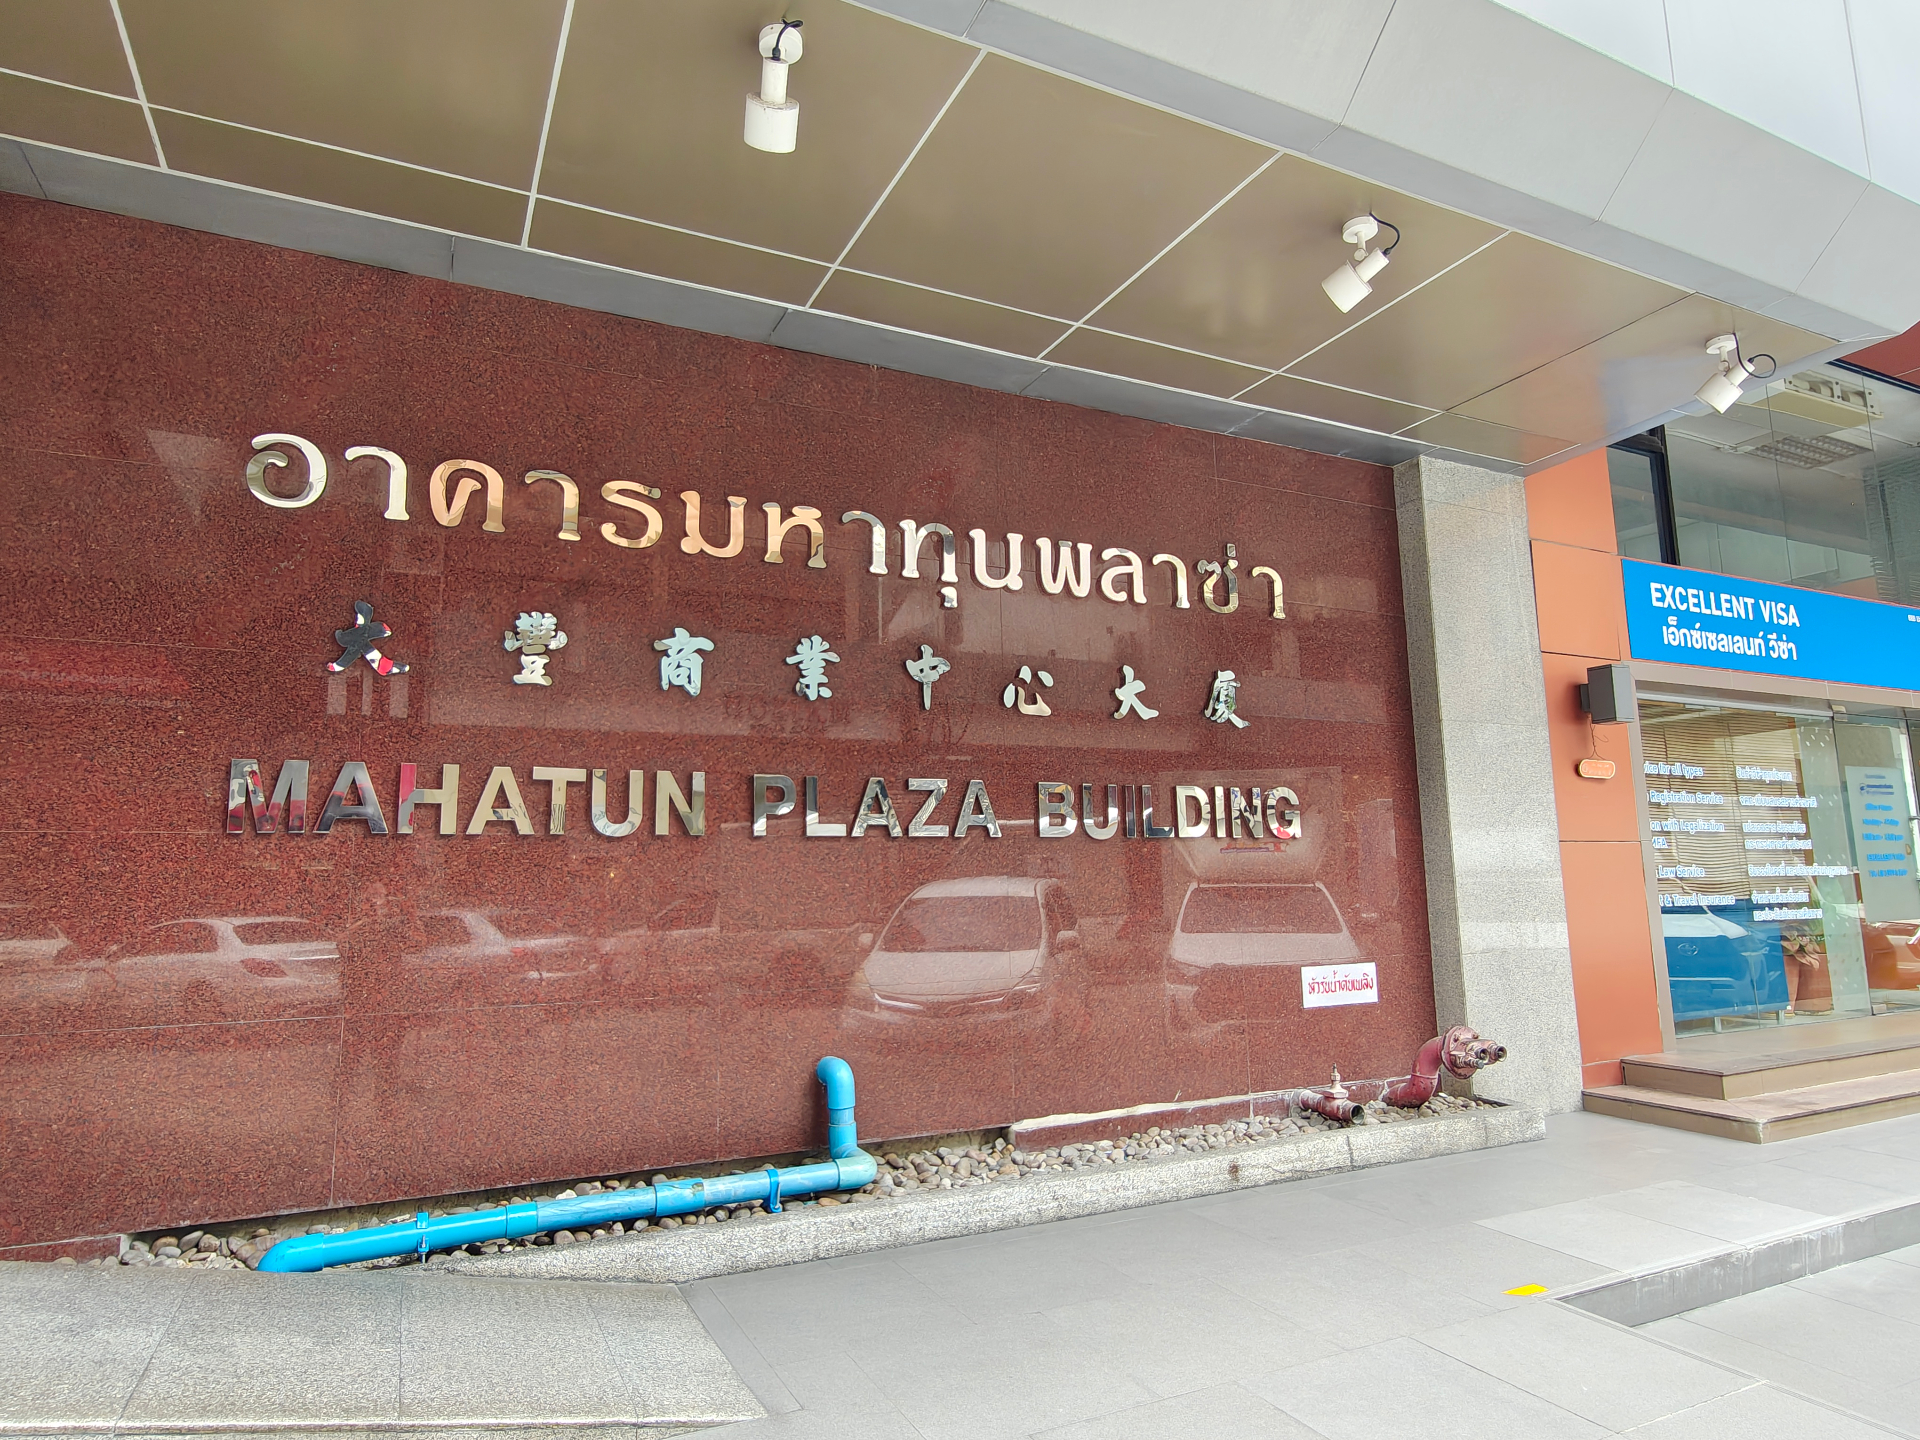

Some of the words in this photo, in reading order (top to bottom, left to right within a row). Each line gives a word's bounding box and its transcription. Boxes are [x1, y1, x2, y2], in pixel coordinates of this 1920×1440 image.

[246, 433, 1286, 620] อาคารมหาทุนพลาซ่า
[1650, 582, 1755, 621] EXCELLENT
[1759, 599, 1800, 627] VISA
[1662, 615, 1766, 657] เอ็กซ์เซลเลนท์
[1767, 632, 1798, 661] วีซ่า
[1659, 762, 1670, 774] for
[1671, 763, 1682, 776] all
[1682, 764, 1704, 779] types
[226, 758, 707, 837] MAHATUN
[752, 773, 1002, 839] PLAZA
[1038, 781, 1302, 841] BUILDING
[1650, 790, 1696, 805] Registration
[1696, 791, 1724, 805] Service
[1662, 818, 1680, 831] with
[1680, 818, 1725, 834] Legalization
[1658, 865, 1676, 878] Law
[1676, 864, 1705, 877] Service
[1672, 893, 1698, 906] Travel
[1698, 894, 1735, 906] Insurance
[1308, 969, 1374, 995] หัวรับน้ำดับเพลิง
